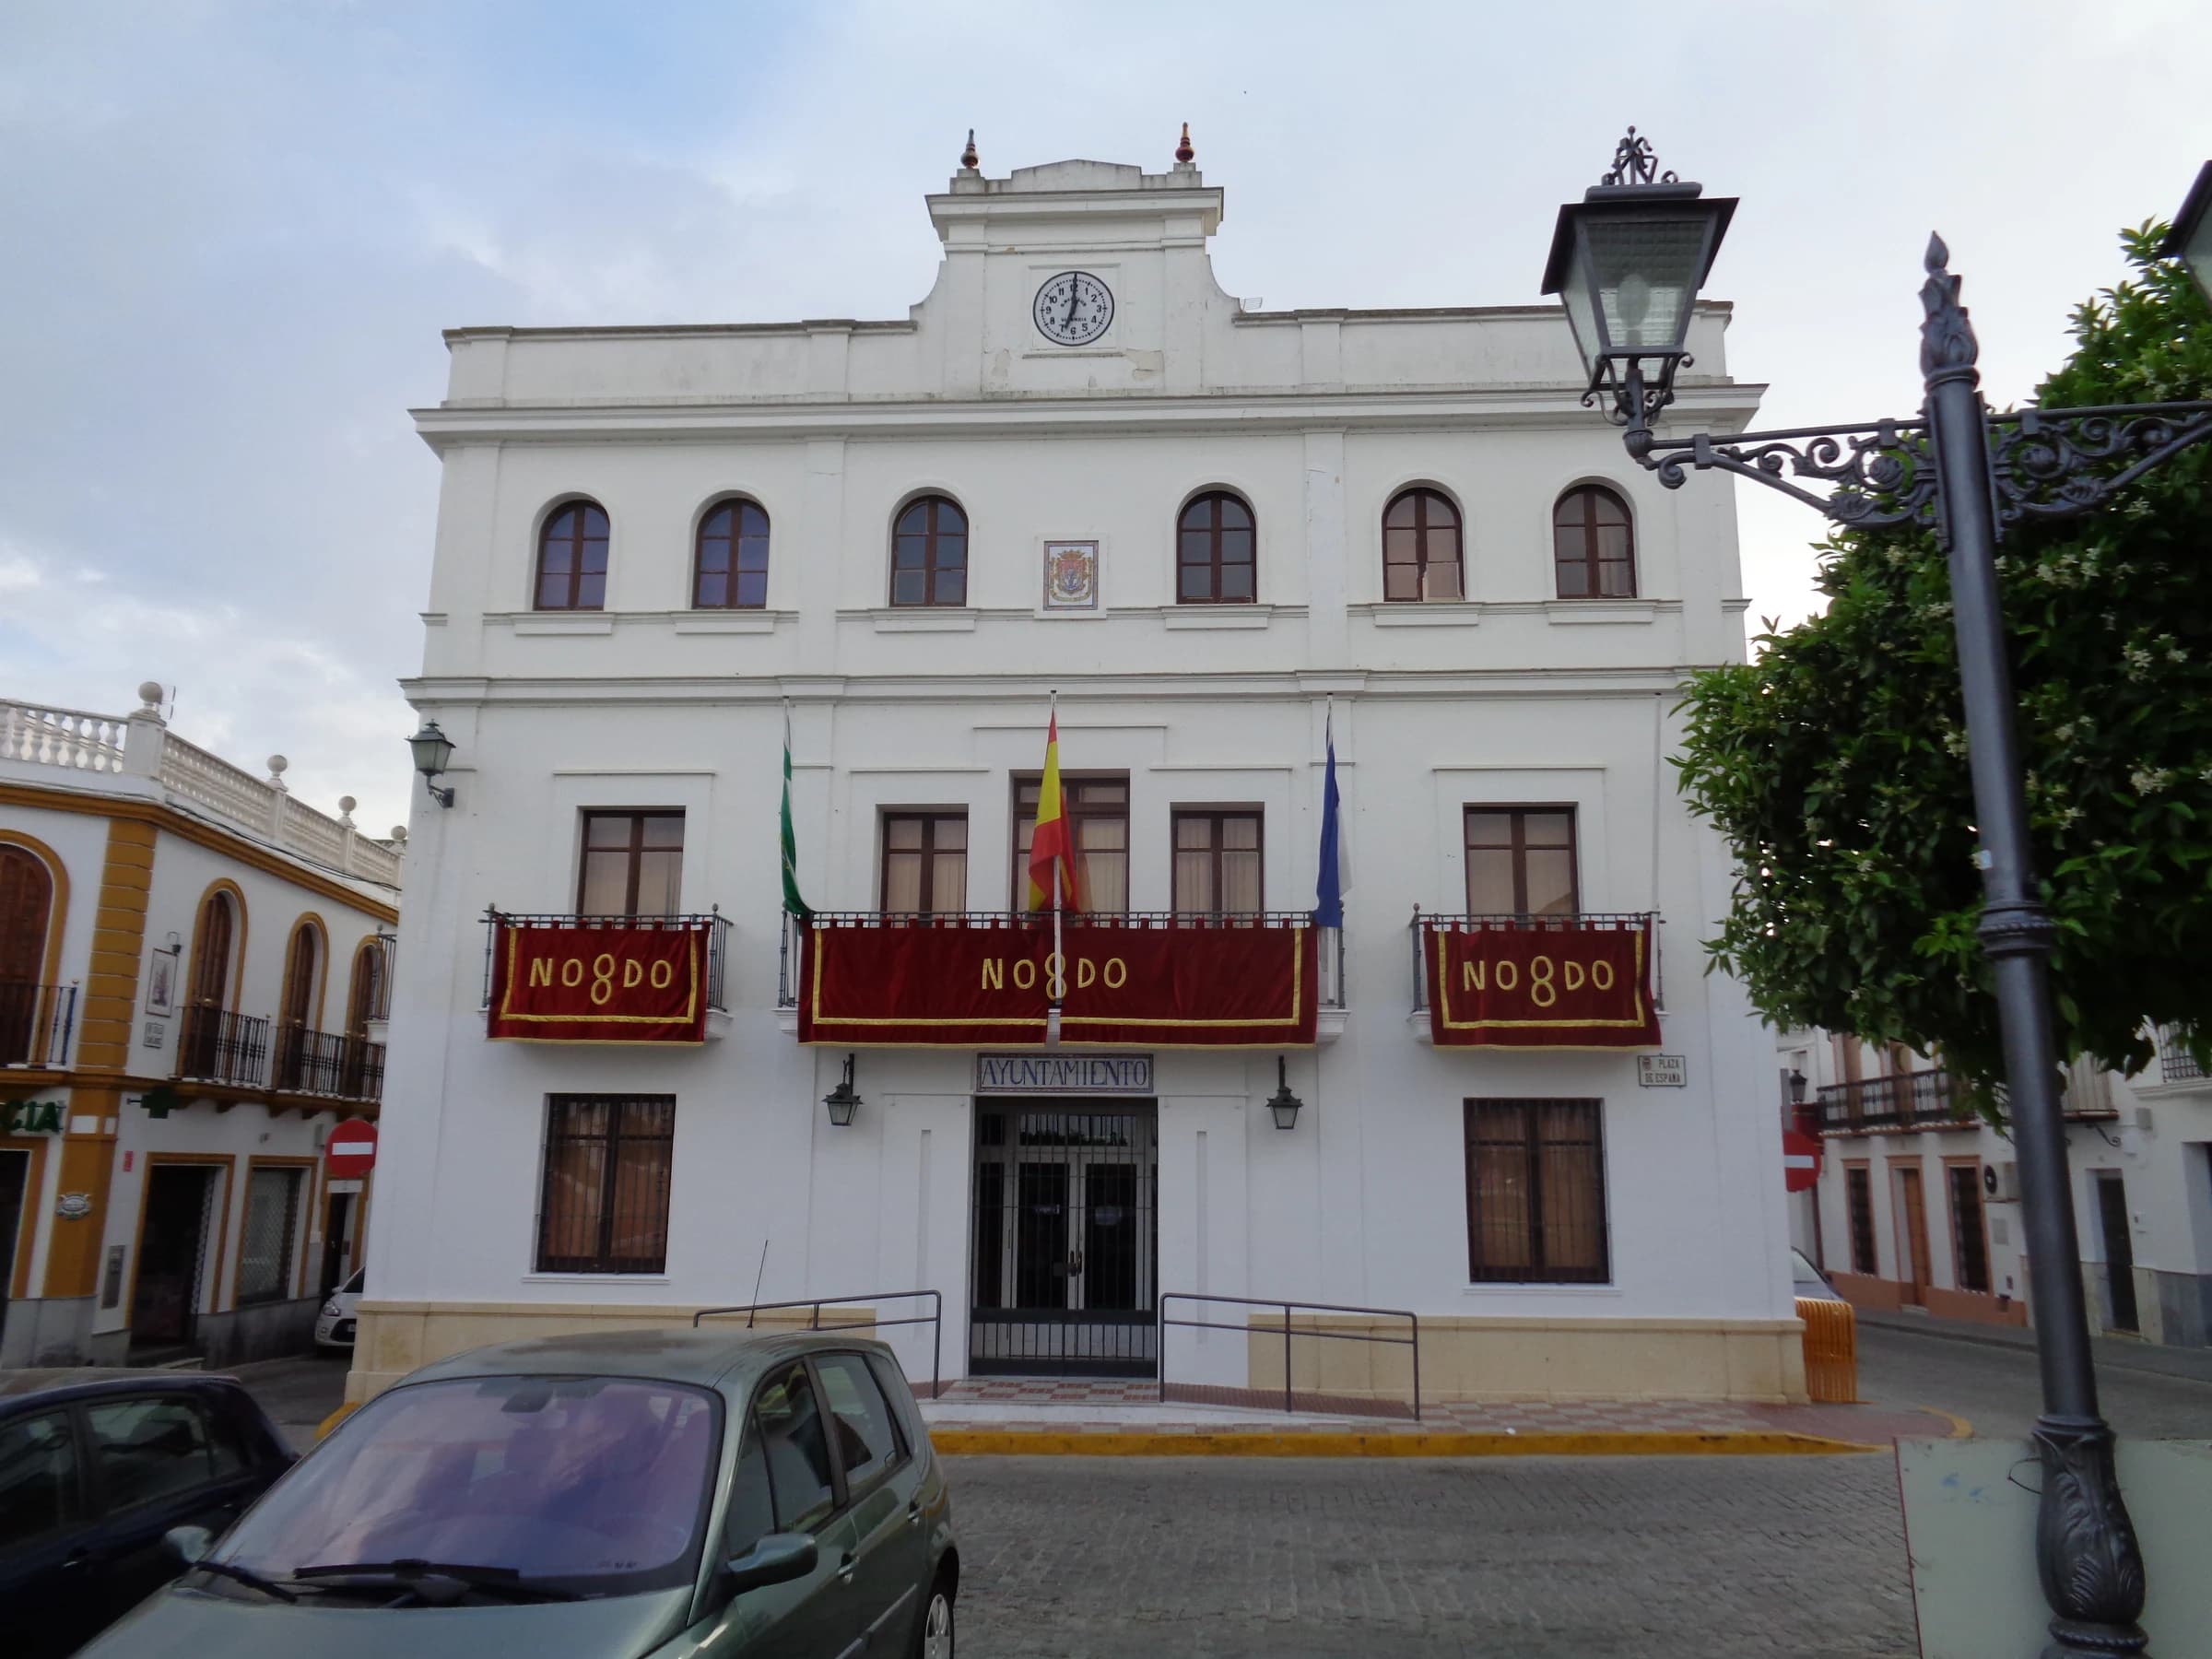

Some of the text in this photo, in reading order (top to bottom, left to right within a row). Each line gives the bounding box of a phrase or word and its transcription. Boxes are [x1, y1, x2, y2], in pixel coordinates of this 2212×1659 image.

[1049, 296, 1058, 304] 10
[1091, 294, 1097, 303] 2
[1045, 306, 1052, 314] 9
[1096, 304, 1102, 312] 3
[1091, 315, 1097, 324] 4
[1081, 324, 1088, 332] 5
[982, 1060, 1147, 1086] AYUNTAMIENTO
